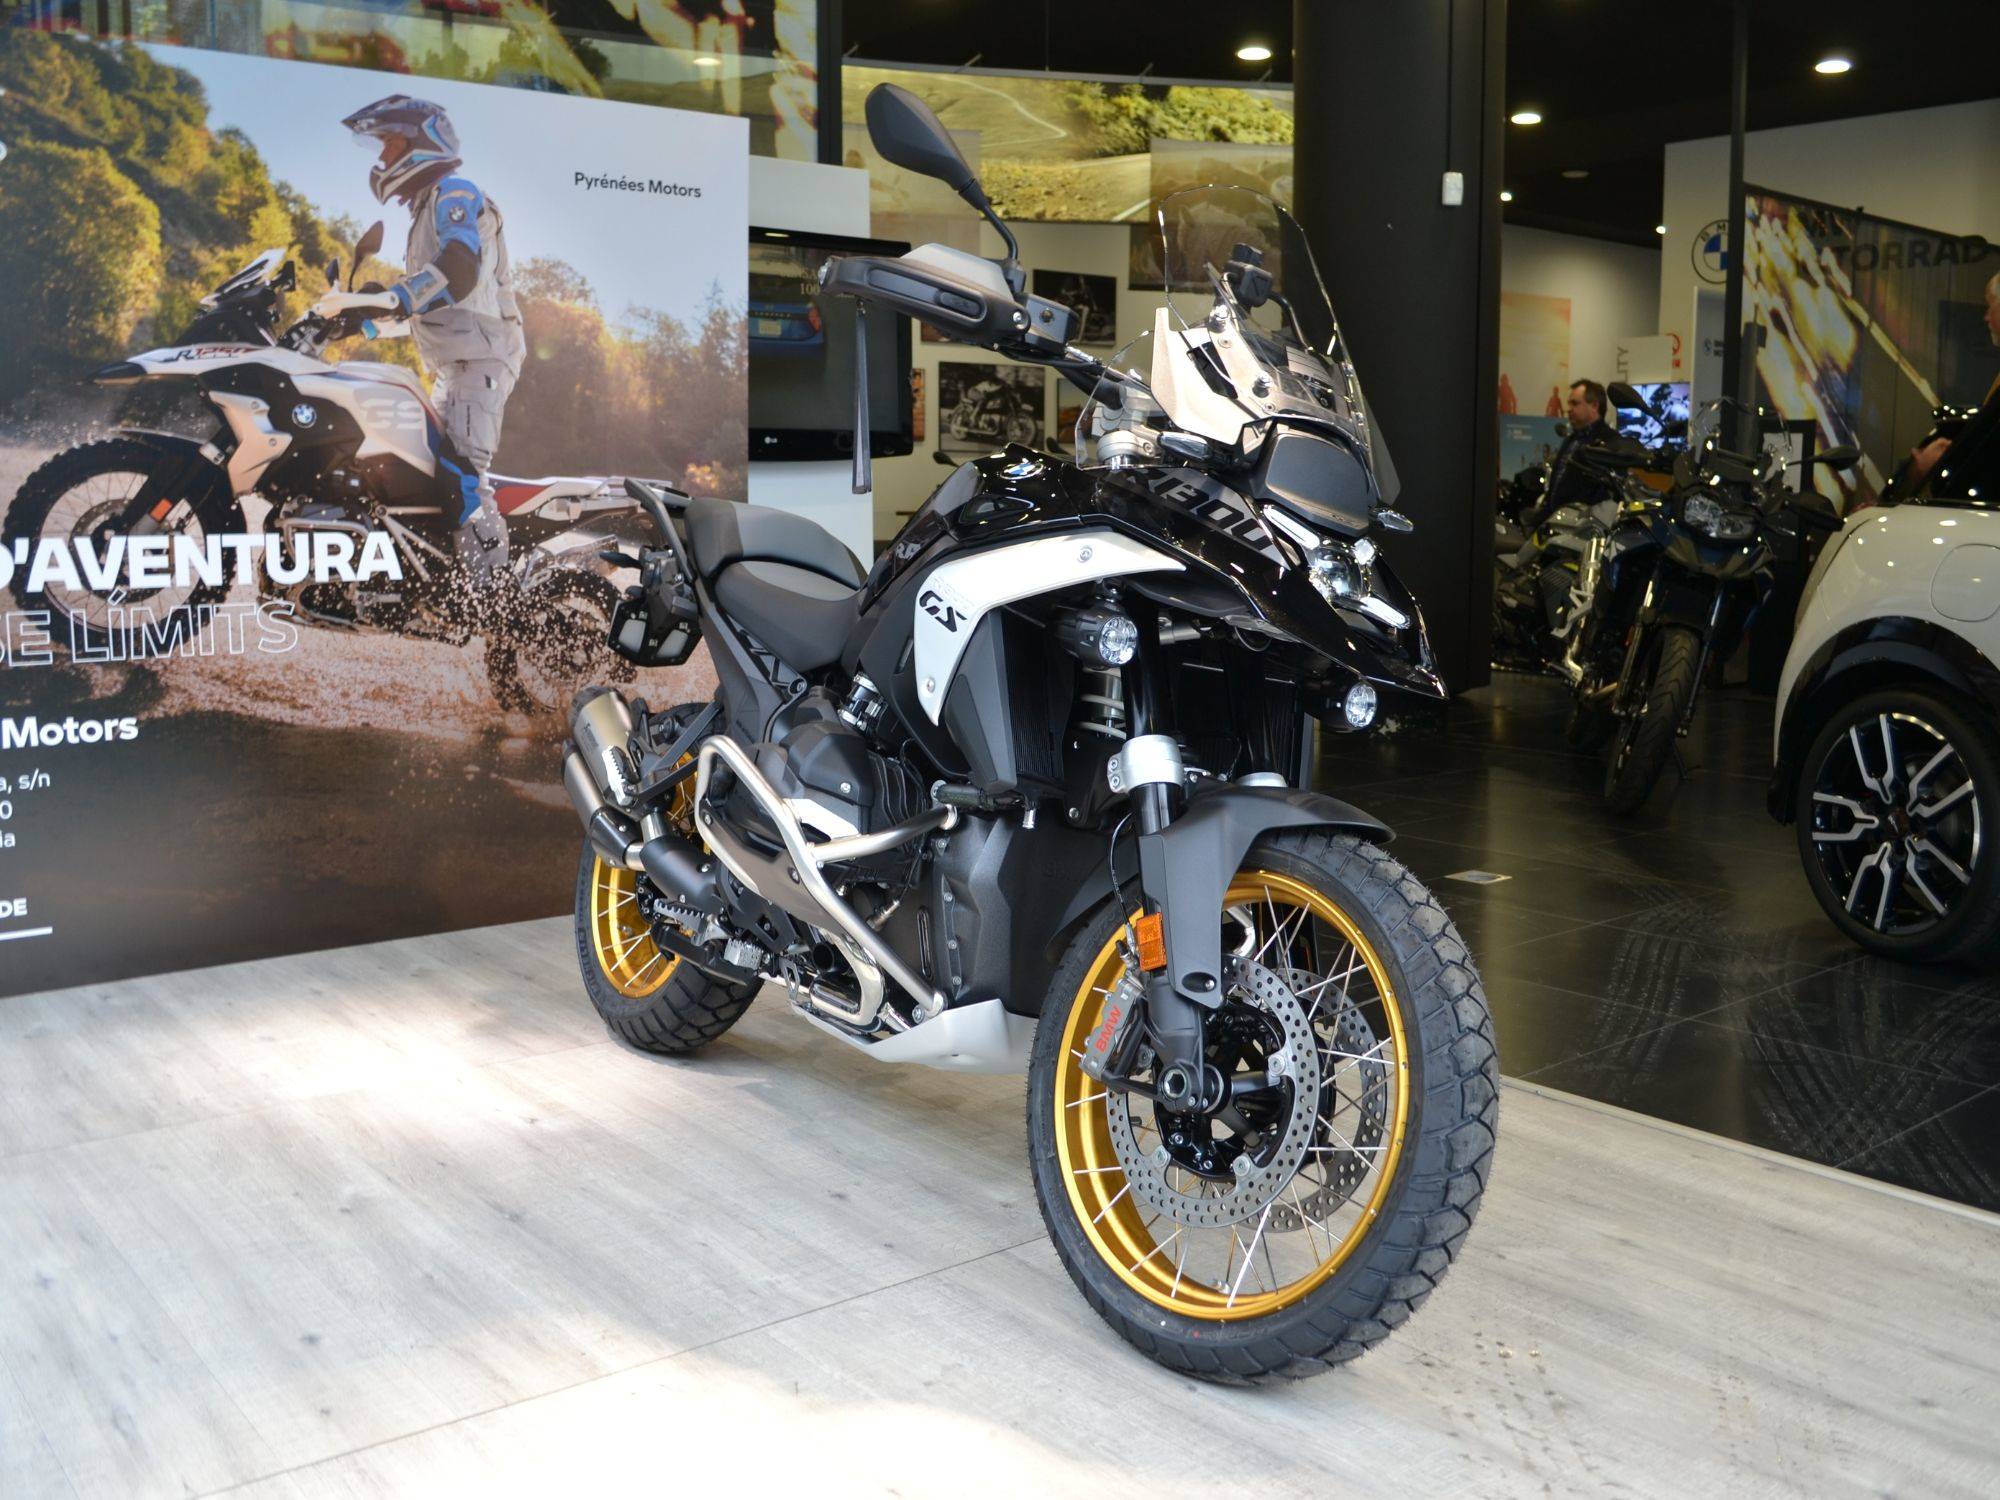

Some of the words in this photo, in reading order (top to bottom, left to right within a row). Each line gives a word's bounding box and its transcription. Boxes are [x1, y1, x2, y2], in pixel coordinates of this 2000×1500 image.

[574, 171, 645, 192] Pyrénées
[648, 179, 702, 198] Motors
[0, 610, 53, 668] E
[71, 586, 299, 664] LÍMITS
[1, 715, 139, 750] Motors
[18, 768, 51, 791] s/n
[1095, 1004, 1122, 1053] BMW
